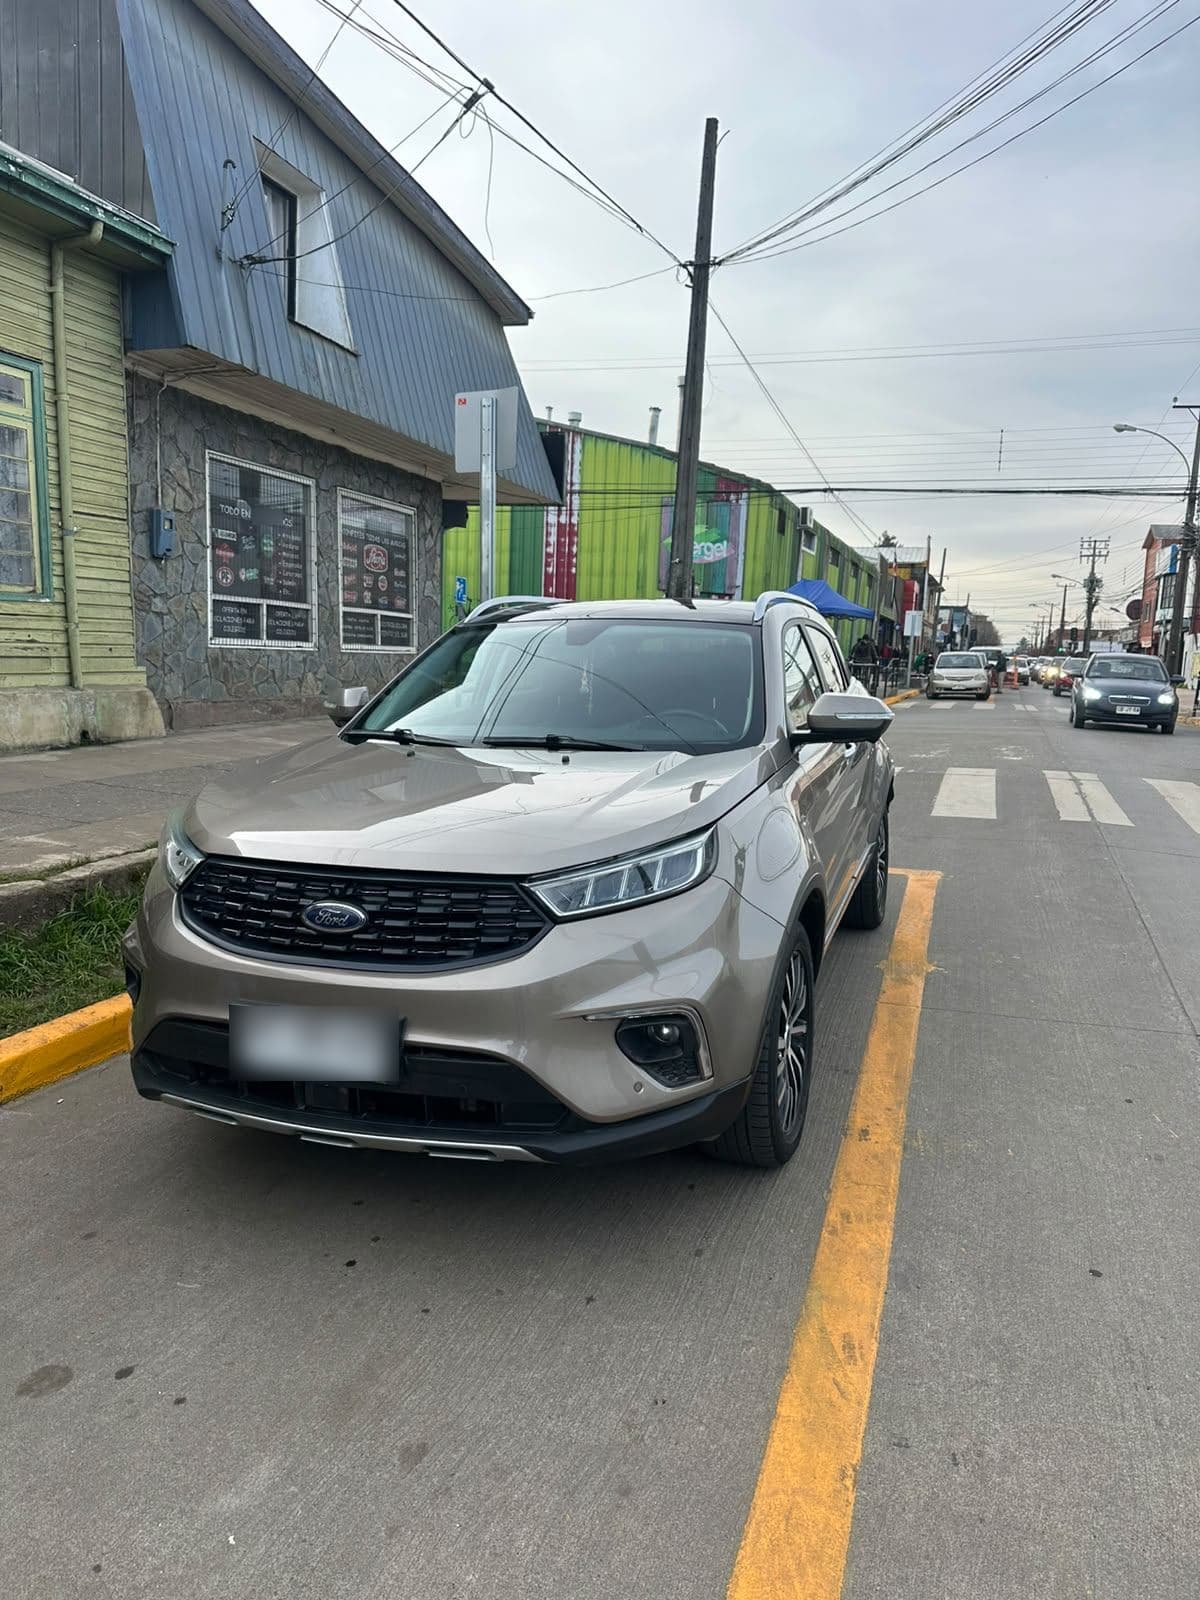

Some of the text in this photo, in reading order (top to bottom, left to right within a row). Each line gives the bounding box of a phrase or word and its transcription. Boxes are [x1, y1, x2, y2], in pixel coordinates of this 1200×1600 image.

[219, 504, 239, 516] TODO
[693, 540, 727, 560] ergel
[314, 908, 350, 927] Ford
